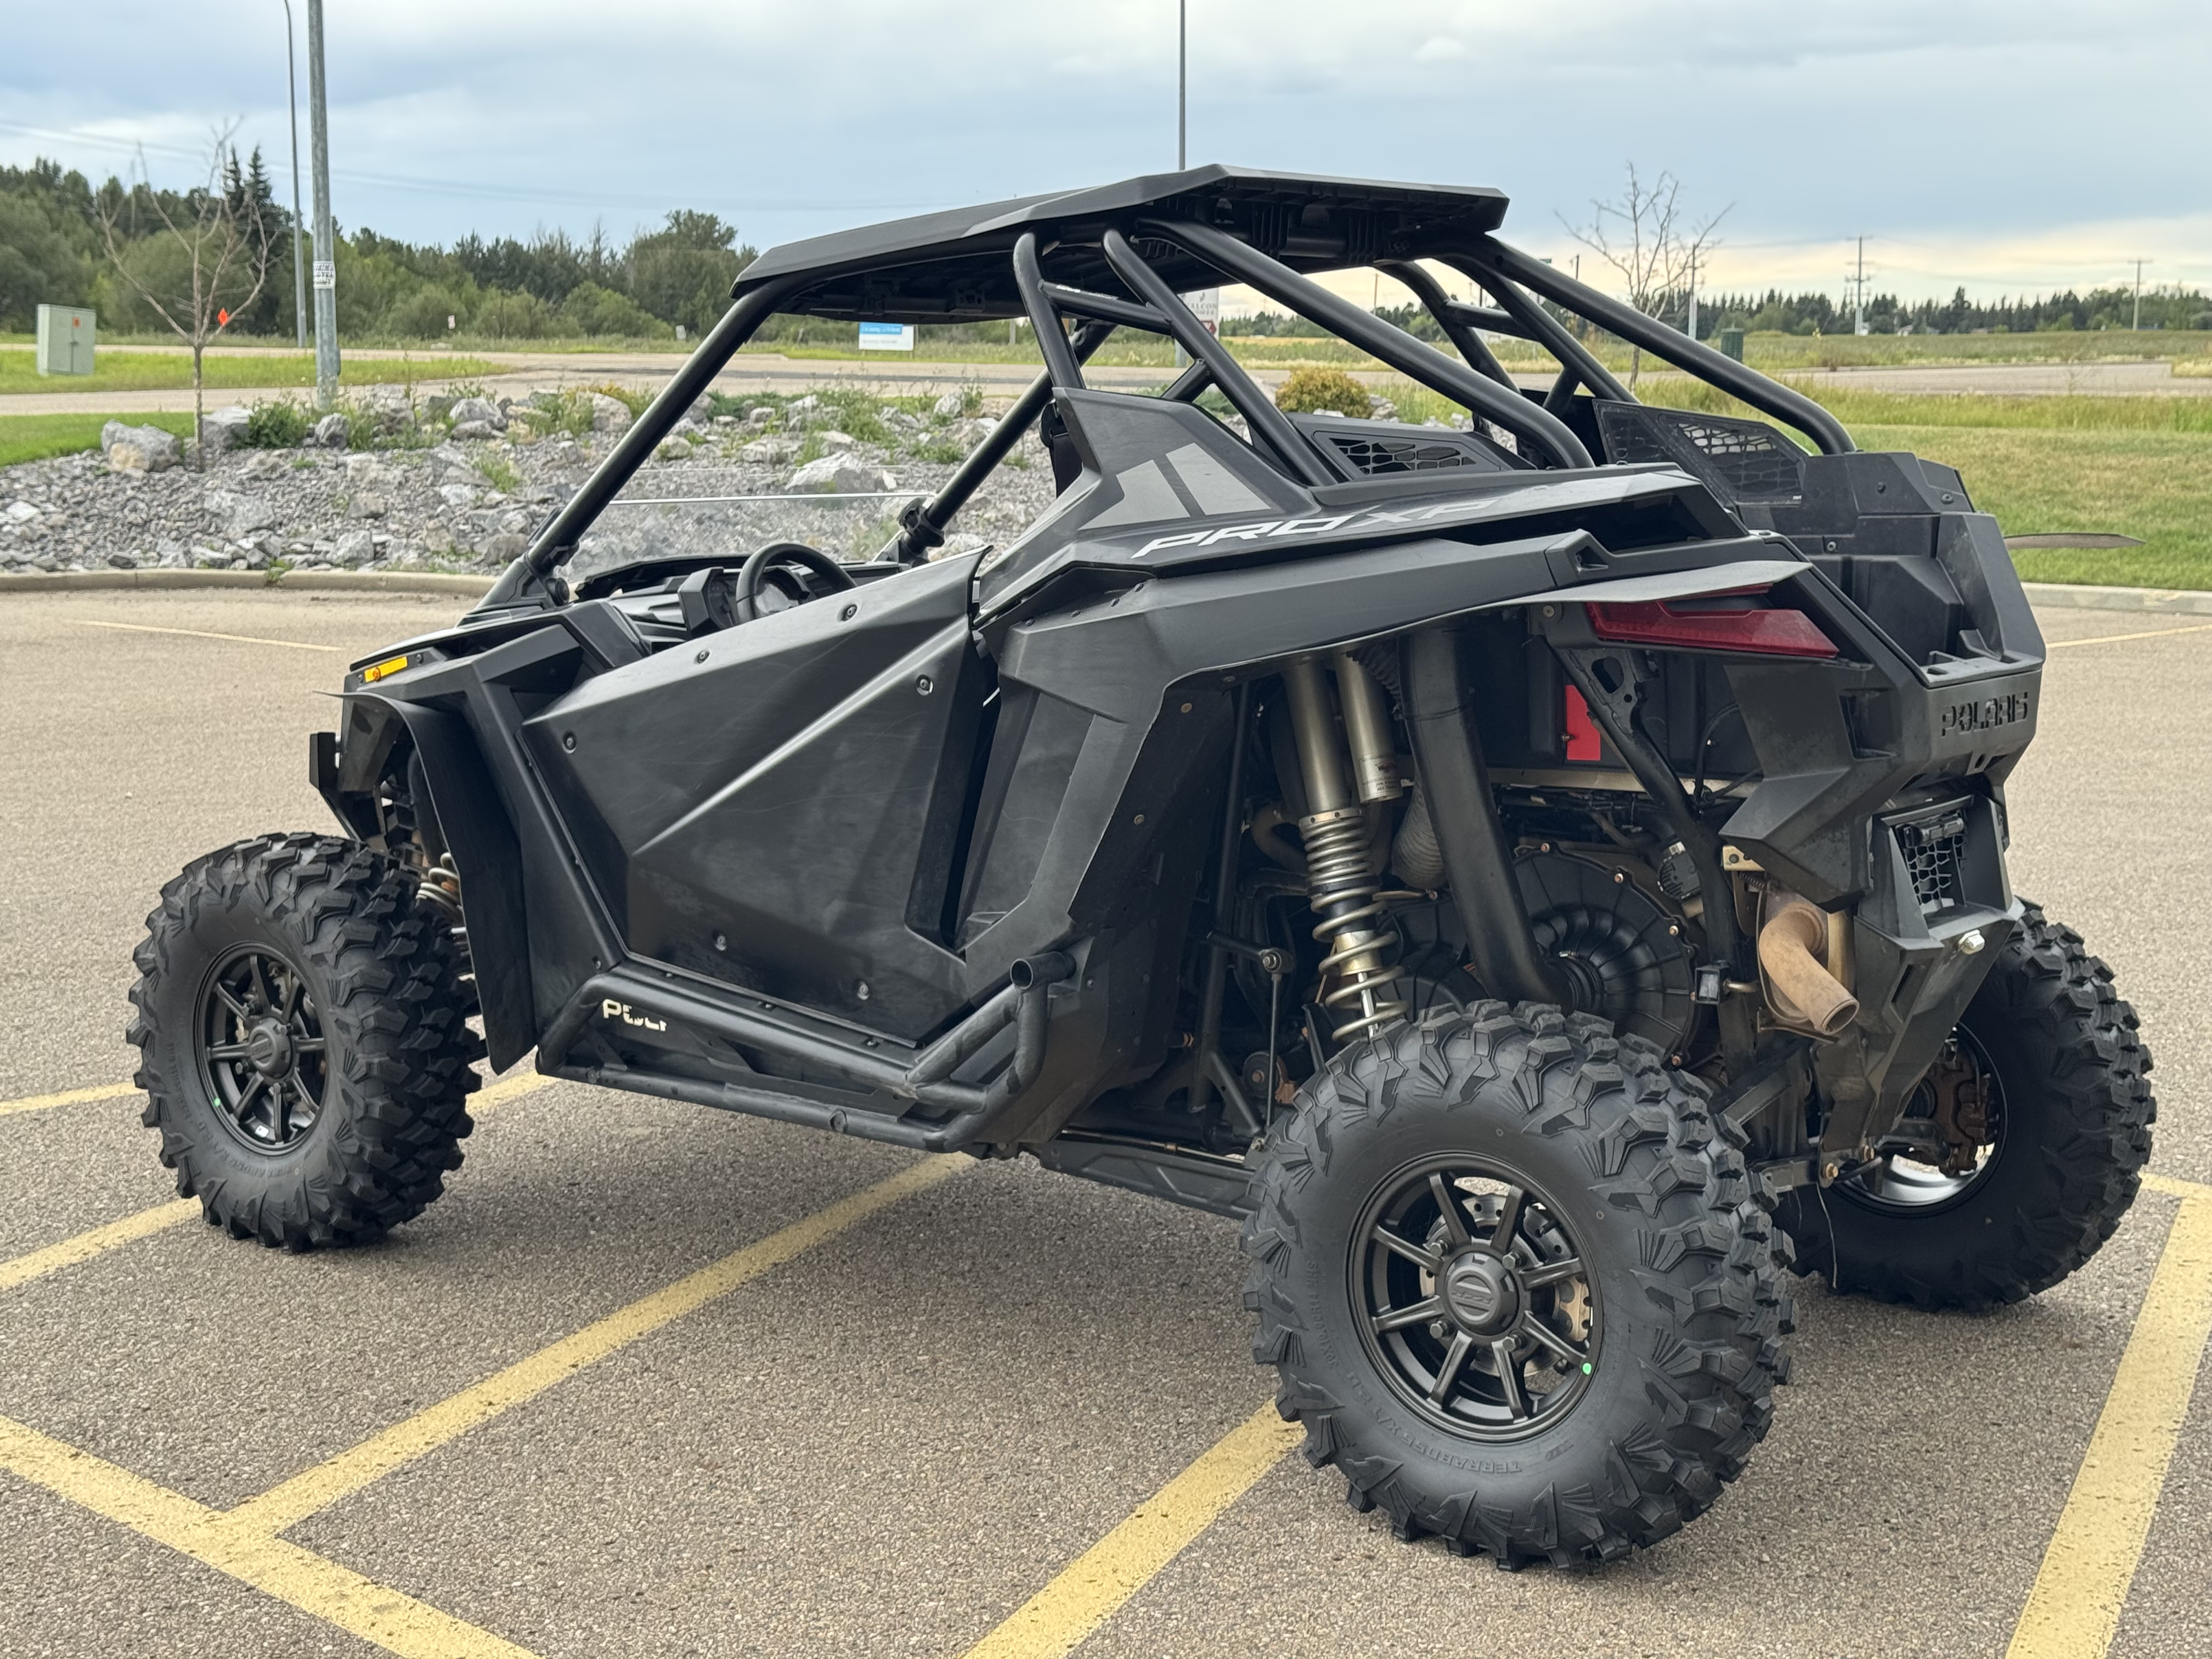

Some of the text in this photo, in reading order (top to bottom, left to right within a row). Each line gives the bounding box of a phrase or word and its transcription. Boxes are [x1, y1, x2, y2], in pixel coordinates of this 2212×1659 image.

[1131, 499, 1500, 559] PRO XP
[1942, 691, 2028, 737] POLARIS
